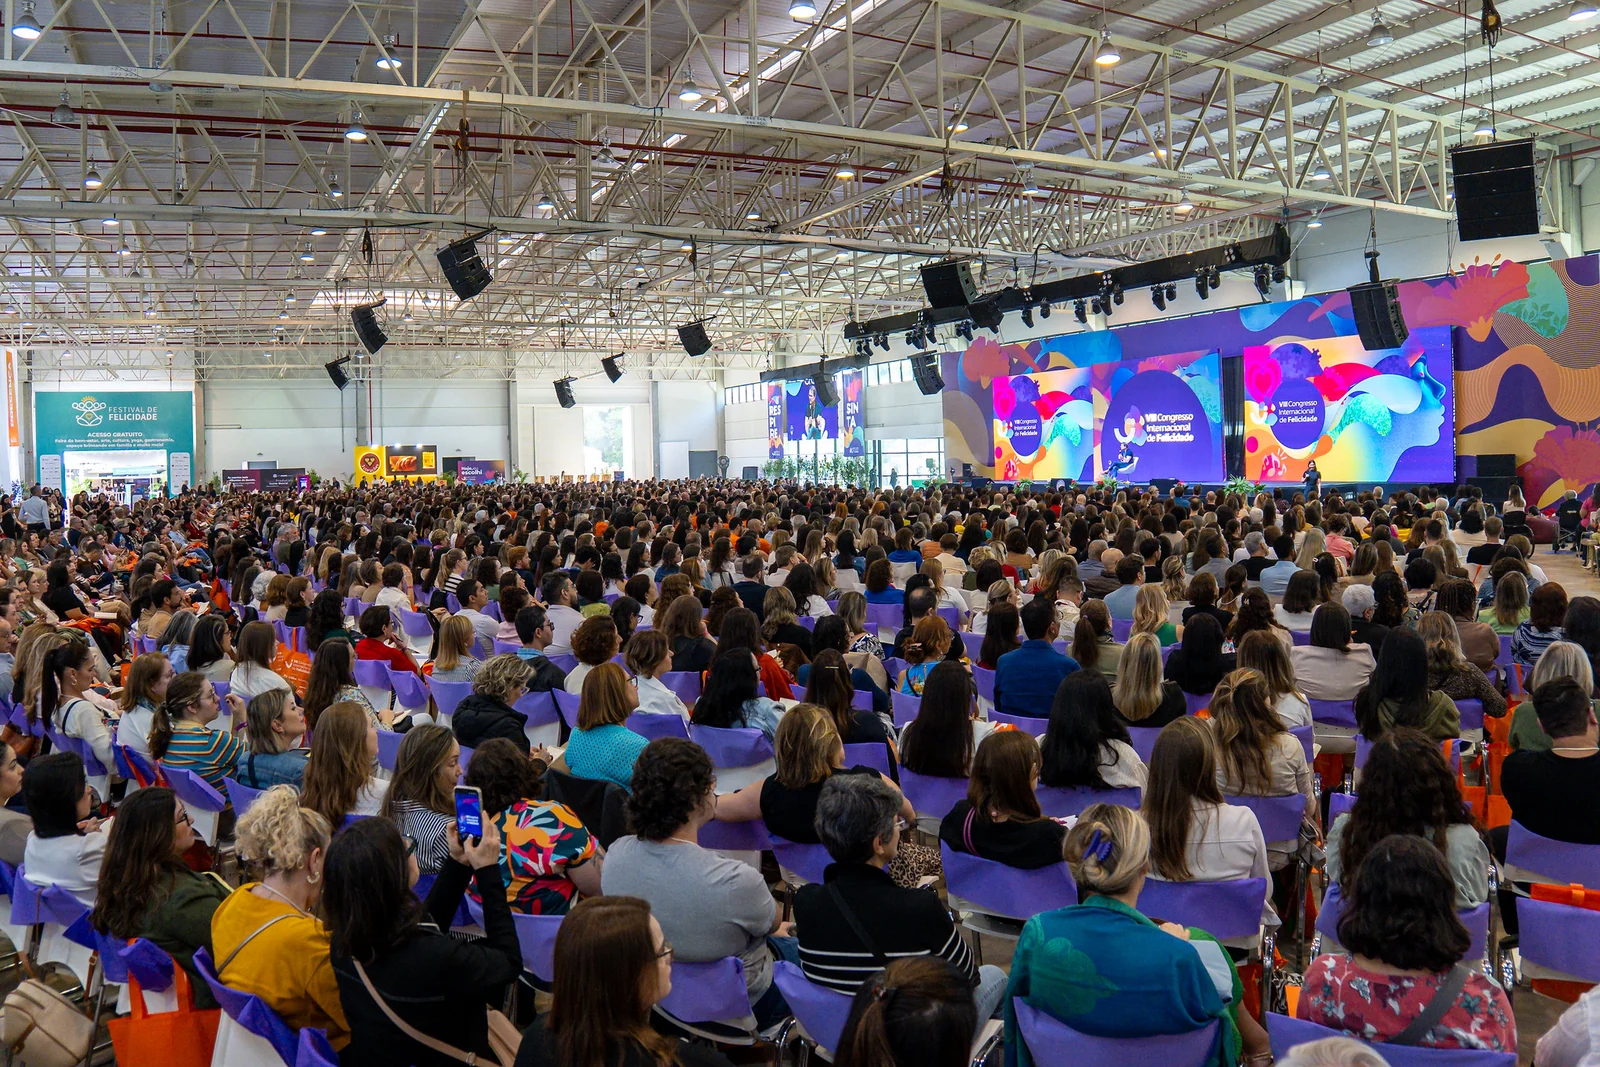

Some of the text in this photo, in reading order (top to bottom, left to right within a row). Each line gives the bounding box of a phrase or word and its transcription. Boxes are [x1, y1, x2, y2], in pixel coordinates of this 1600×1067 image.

[846, 401, 859, 415] SIN
[1288, 400, 1317, 408] Congresso
[769, 404, 781, 416] RES
[1279, 407, 1315, 415] Internacional
[108, 413, 158, 421] FELICIDADE
[769, 416, 776, 428] PI
[846, 415, 857, 428] TA
[1145, 412, 1194, 424] VIII Congresso
[1287, 415, 1318, 423] Felicidade
[1146, 422, 1191, 432] Internacional
[769, 427, 778, 439] RE
[1146, 432, 1195, 442] de Felicidade
